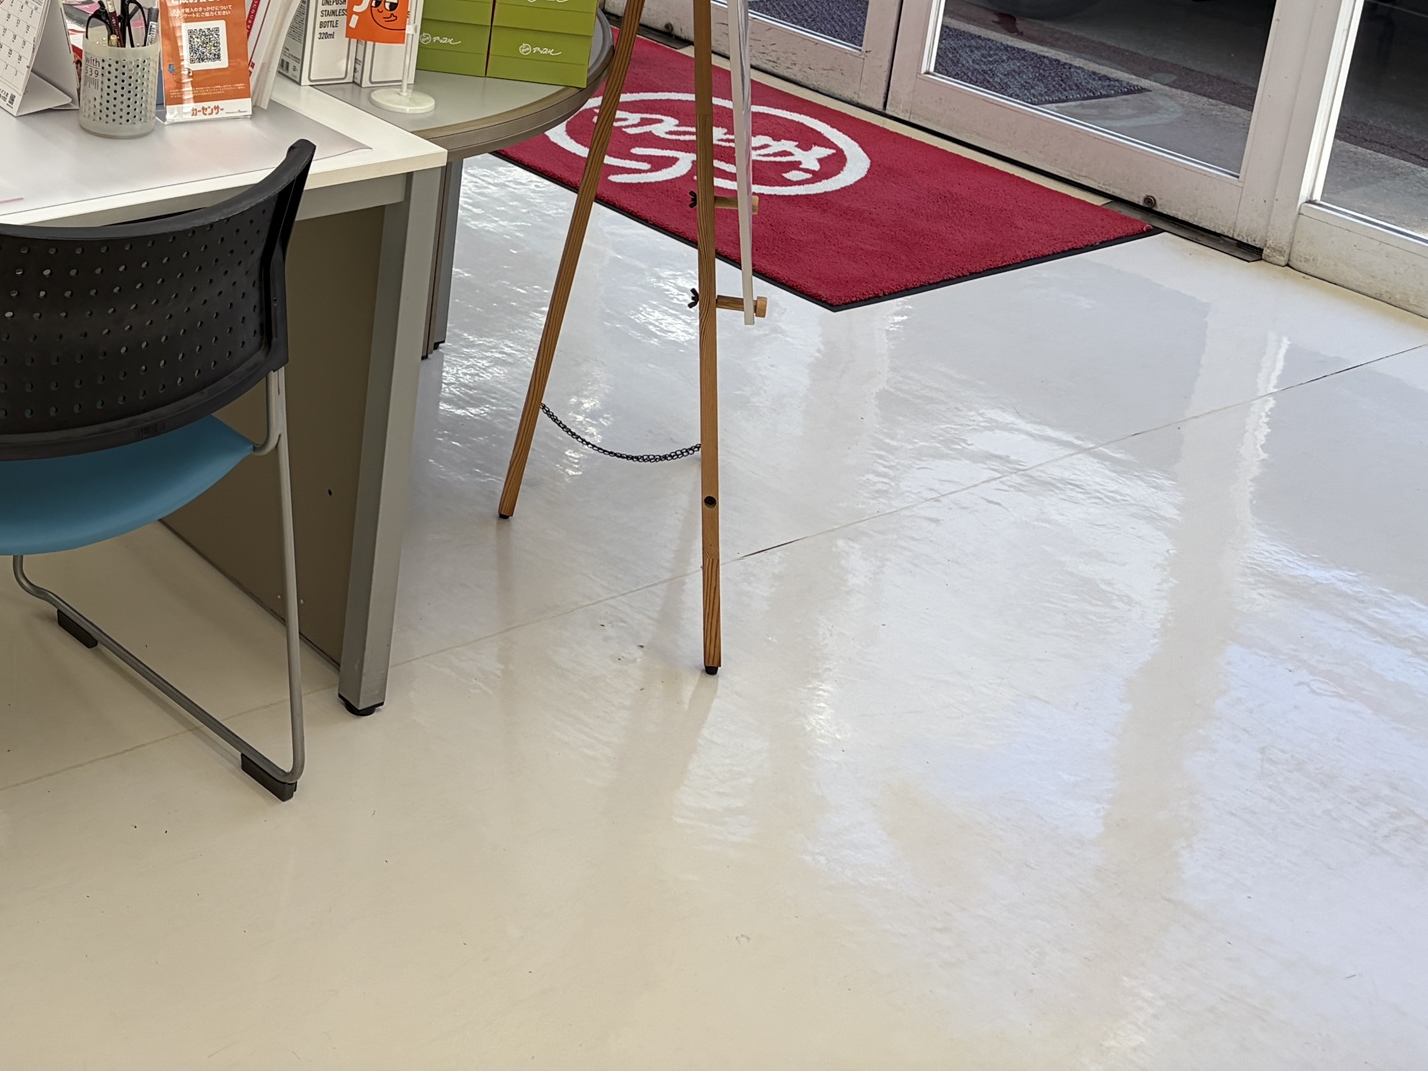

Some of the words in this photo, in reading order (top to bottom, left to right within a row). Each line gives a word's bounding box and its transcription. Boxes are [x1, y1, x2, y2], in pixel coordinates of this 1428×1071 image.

[320, 9, 348, 17] STAINLESS
[319, 20, 339, 29] BOTTLE
[318, 32, 335, 40] 320ml
[84, 56, 101, 67] with
[191, 106, 224, 117] カーセンサー
